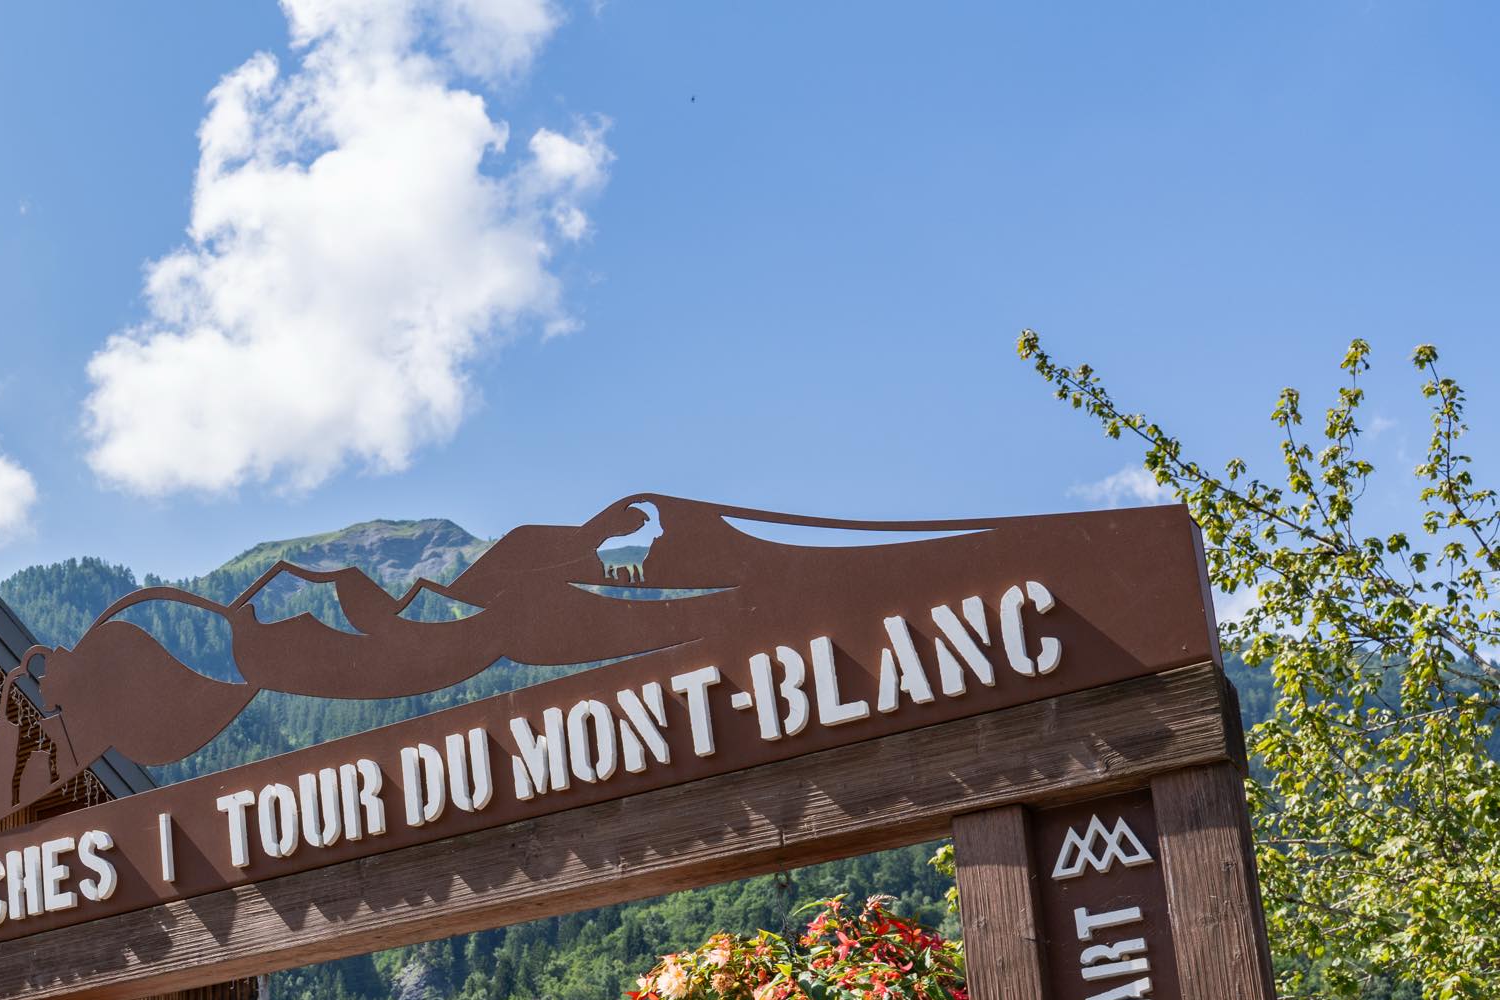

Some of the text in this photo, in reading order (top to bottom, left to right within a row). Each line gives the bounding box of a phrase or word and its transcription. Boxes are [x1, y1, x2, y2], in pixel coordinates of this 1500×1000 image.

[216, 758, 387, 868] TOUR
[400, 727, 493, 827] DU
[510, 580, 1062, 800] MONT-BLANC
